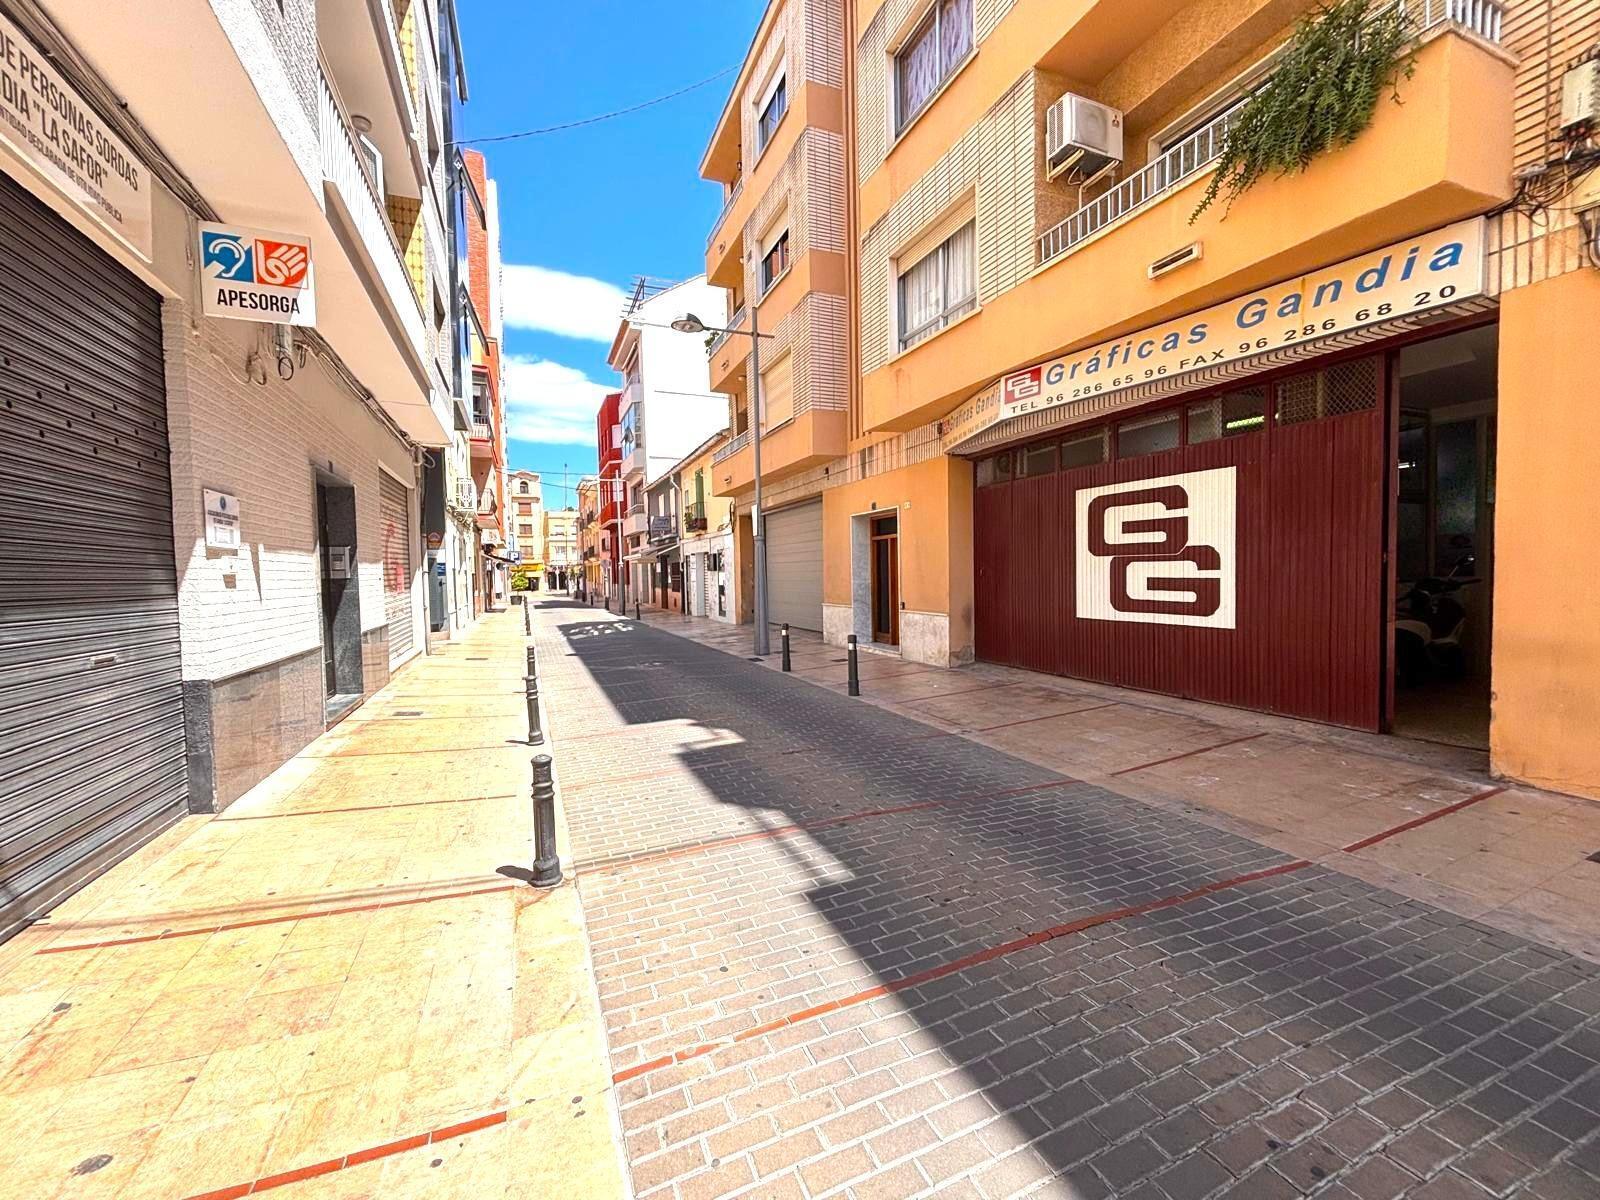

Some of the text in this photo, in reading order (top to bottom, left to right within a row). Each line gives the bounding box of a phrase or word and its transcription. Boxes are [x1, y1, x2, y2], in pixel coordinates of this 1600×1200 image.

[20, 49, 94, 146] PERSONAS
[96, 129, 138, 191] SORDAS
[62, 129, 108, 188] SAFOR"
[217, 288, 300, 314] APESORGA
[1011, 285, 1457, 413] TEL 96 286 65 96 FAX 96 286 68 20
[1045, 242, 1464, 386] Gráficas Gandia
